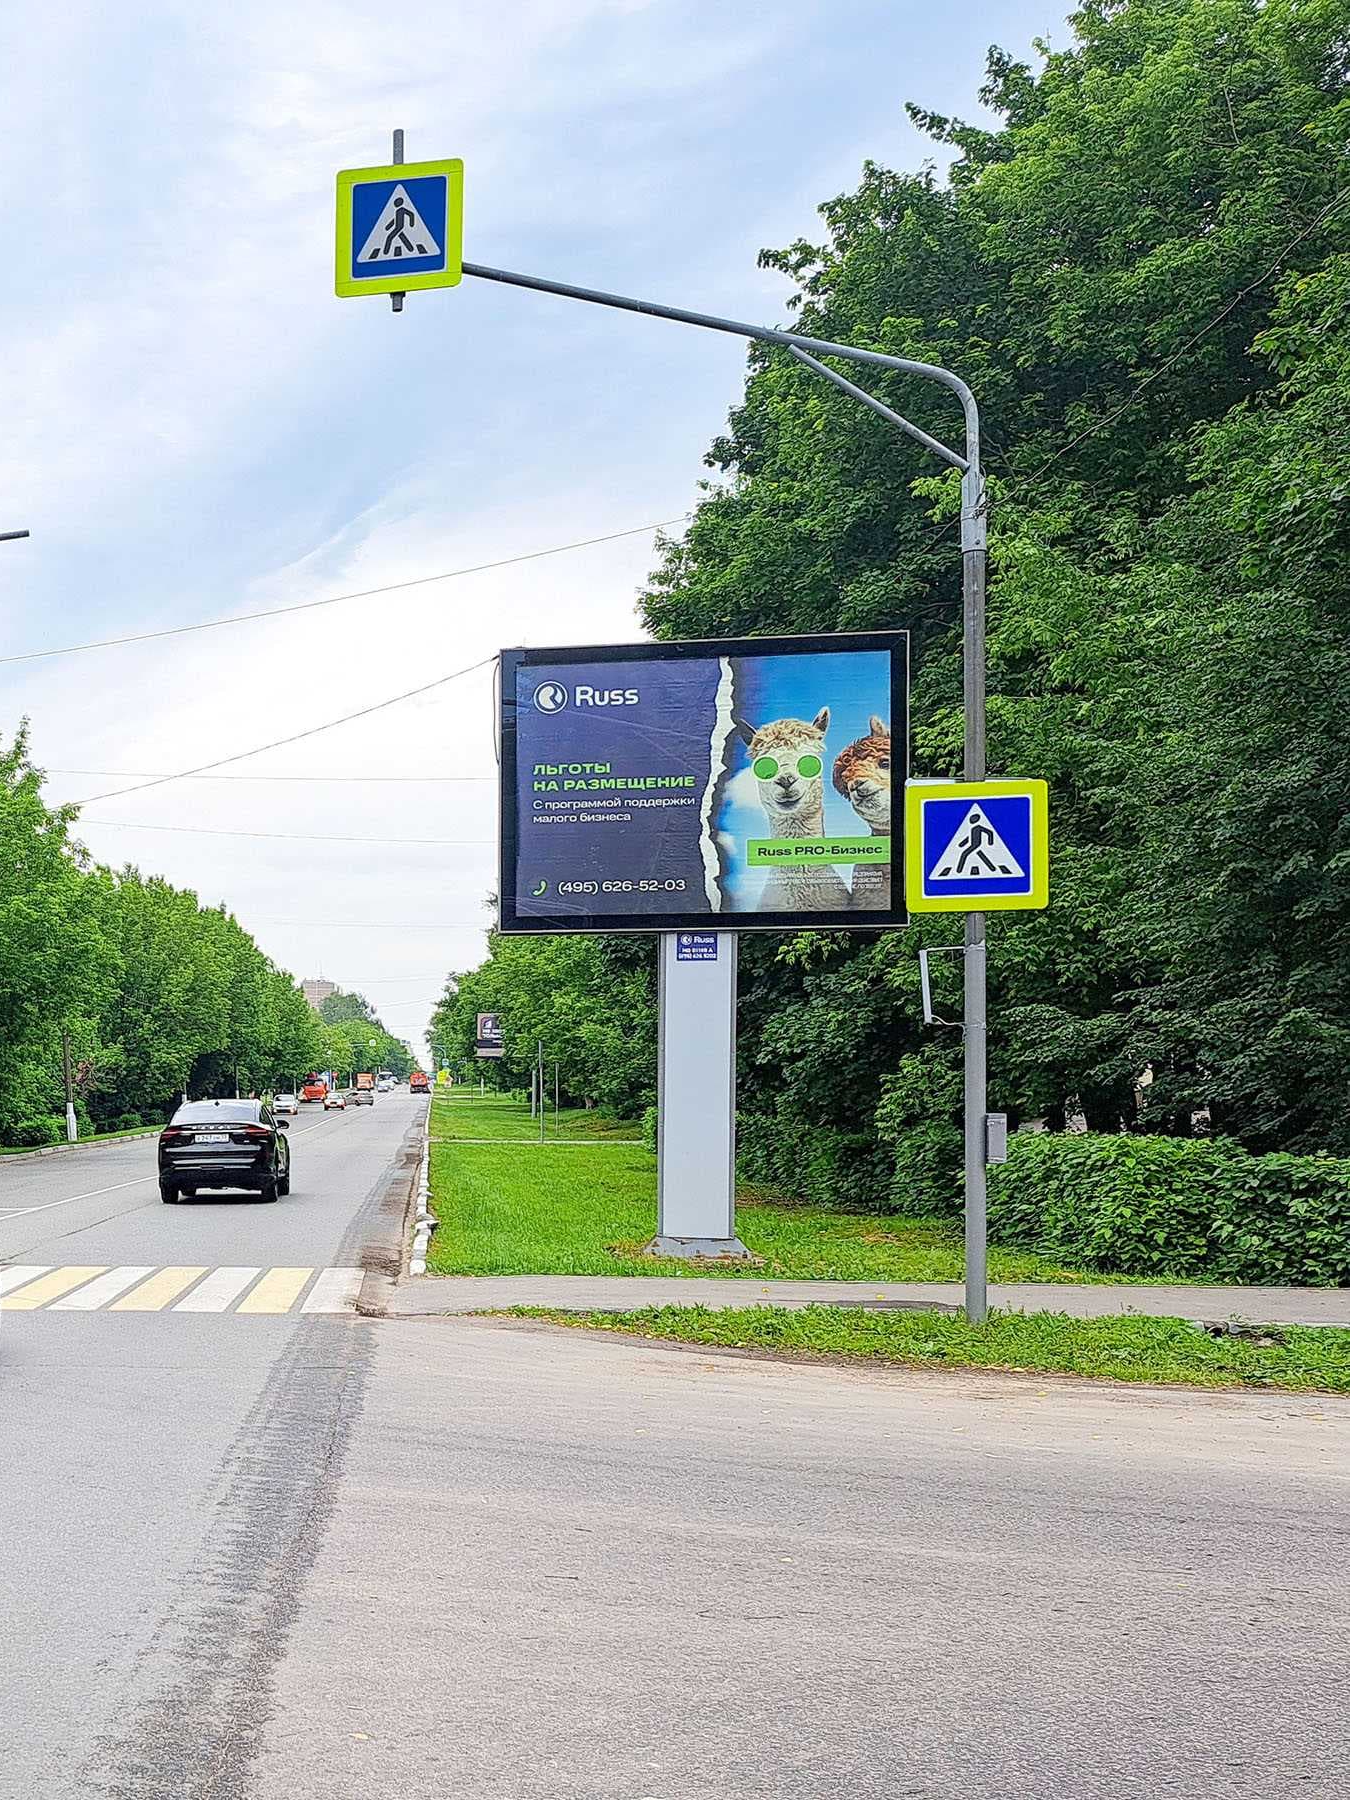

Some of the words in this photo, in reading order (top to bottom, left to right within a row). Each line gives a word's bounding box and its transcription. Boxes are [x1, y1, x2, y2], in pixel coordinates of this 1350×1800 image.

[575, 686, 639, 707] Russ
[533, 762, 611, 776] ЛЬГОТЫ
[533, 780, 559, 792] НА
[564, 776, 696, 791] РАЗМЕЩЕНИЕ
[533, 800, 544, 810] С
[545, 797, 622, 811] программой
[624, 797, 696, 809] поддержки
[533, 814, 577, 824] малого
[579, 812, 632, 823] бизнеса
[757, 847, 792, 857] Russ
[794, 845, 883, 856] PRO-Бизнес
[558, 880, 599, 895] (495)
[602, 879, 687, 892] 626-52-03
